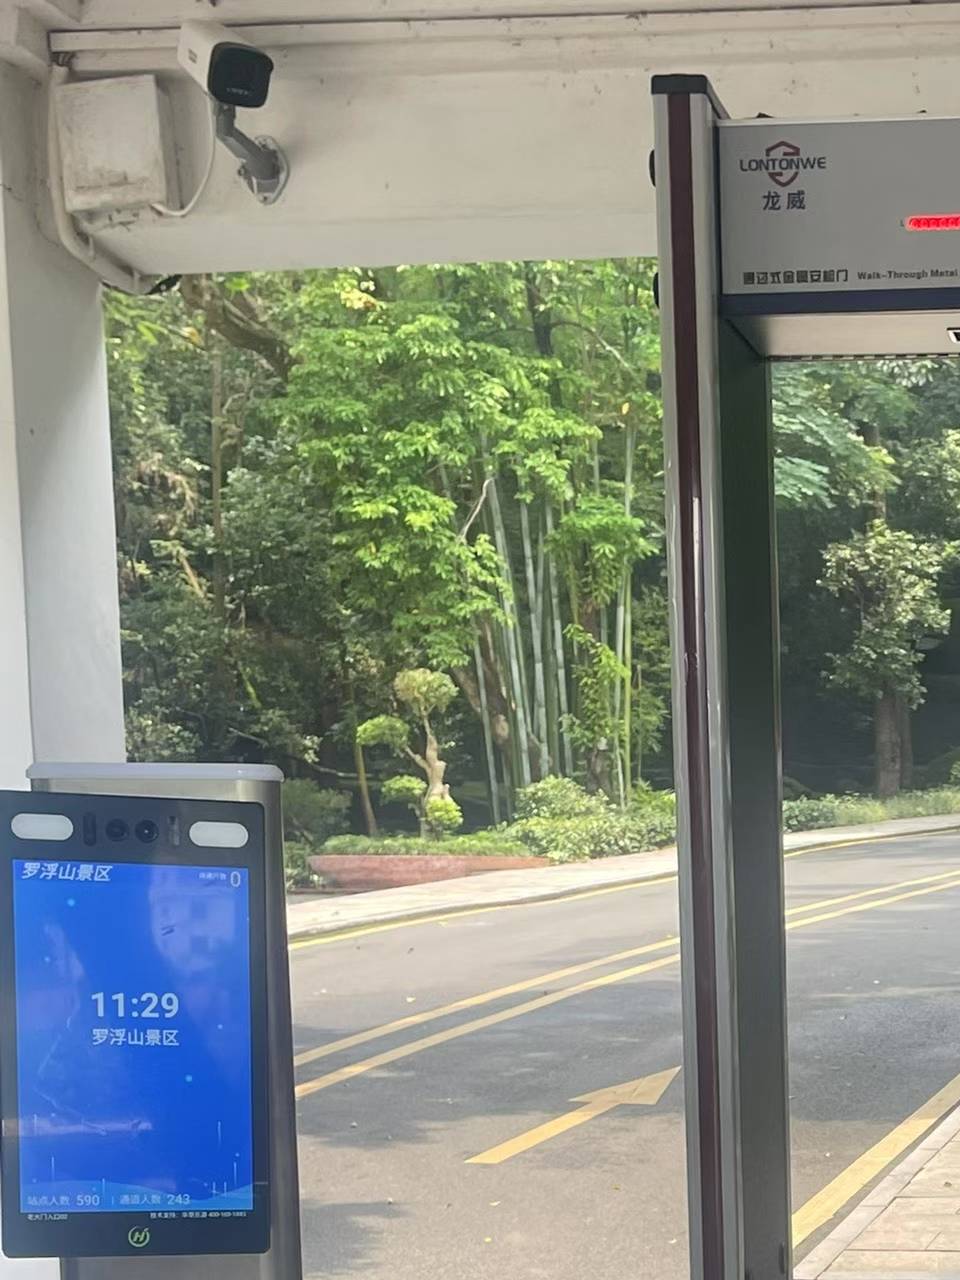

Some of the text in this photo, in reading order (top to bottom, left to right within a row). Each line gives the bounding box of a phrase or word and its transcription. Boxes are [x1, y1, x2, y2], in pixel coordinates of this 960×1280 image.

[739, 156, 827, 172] LONTONWE
[762, 190, 806, 211] 龙威
[857, 270, 928, 280] Walk-Through
[21, 862, 113, 882] 罗浮山景区
[91, 992, 179, 1018] 11:29
[92, 1028, 180, 1046] 罗浮山景区
[76, 1194, 100, 1206] 590
[167, 1194, 190, 1205] 243
